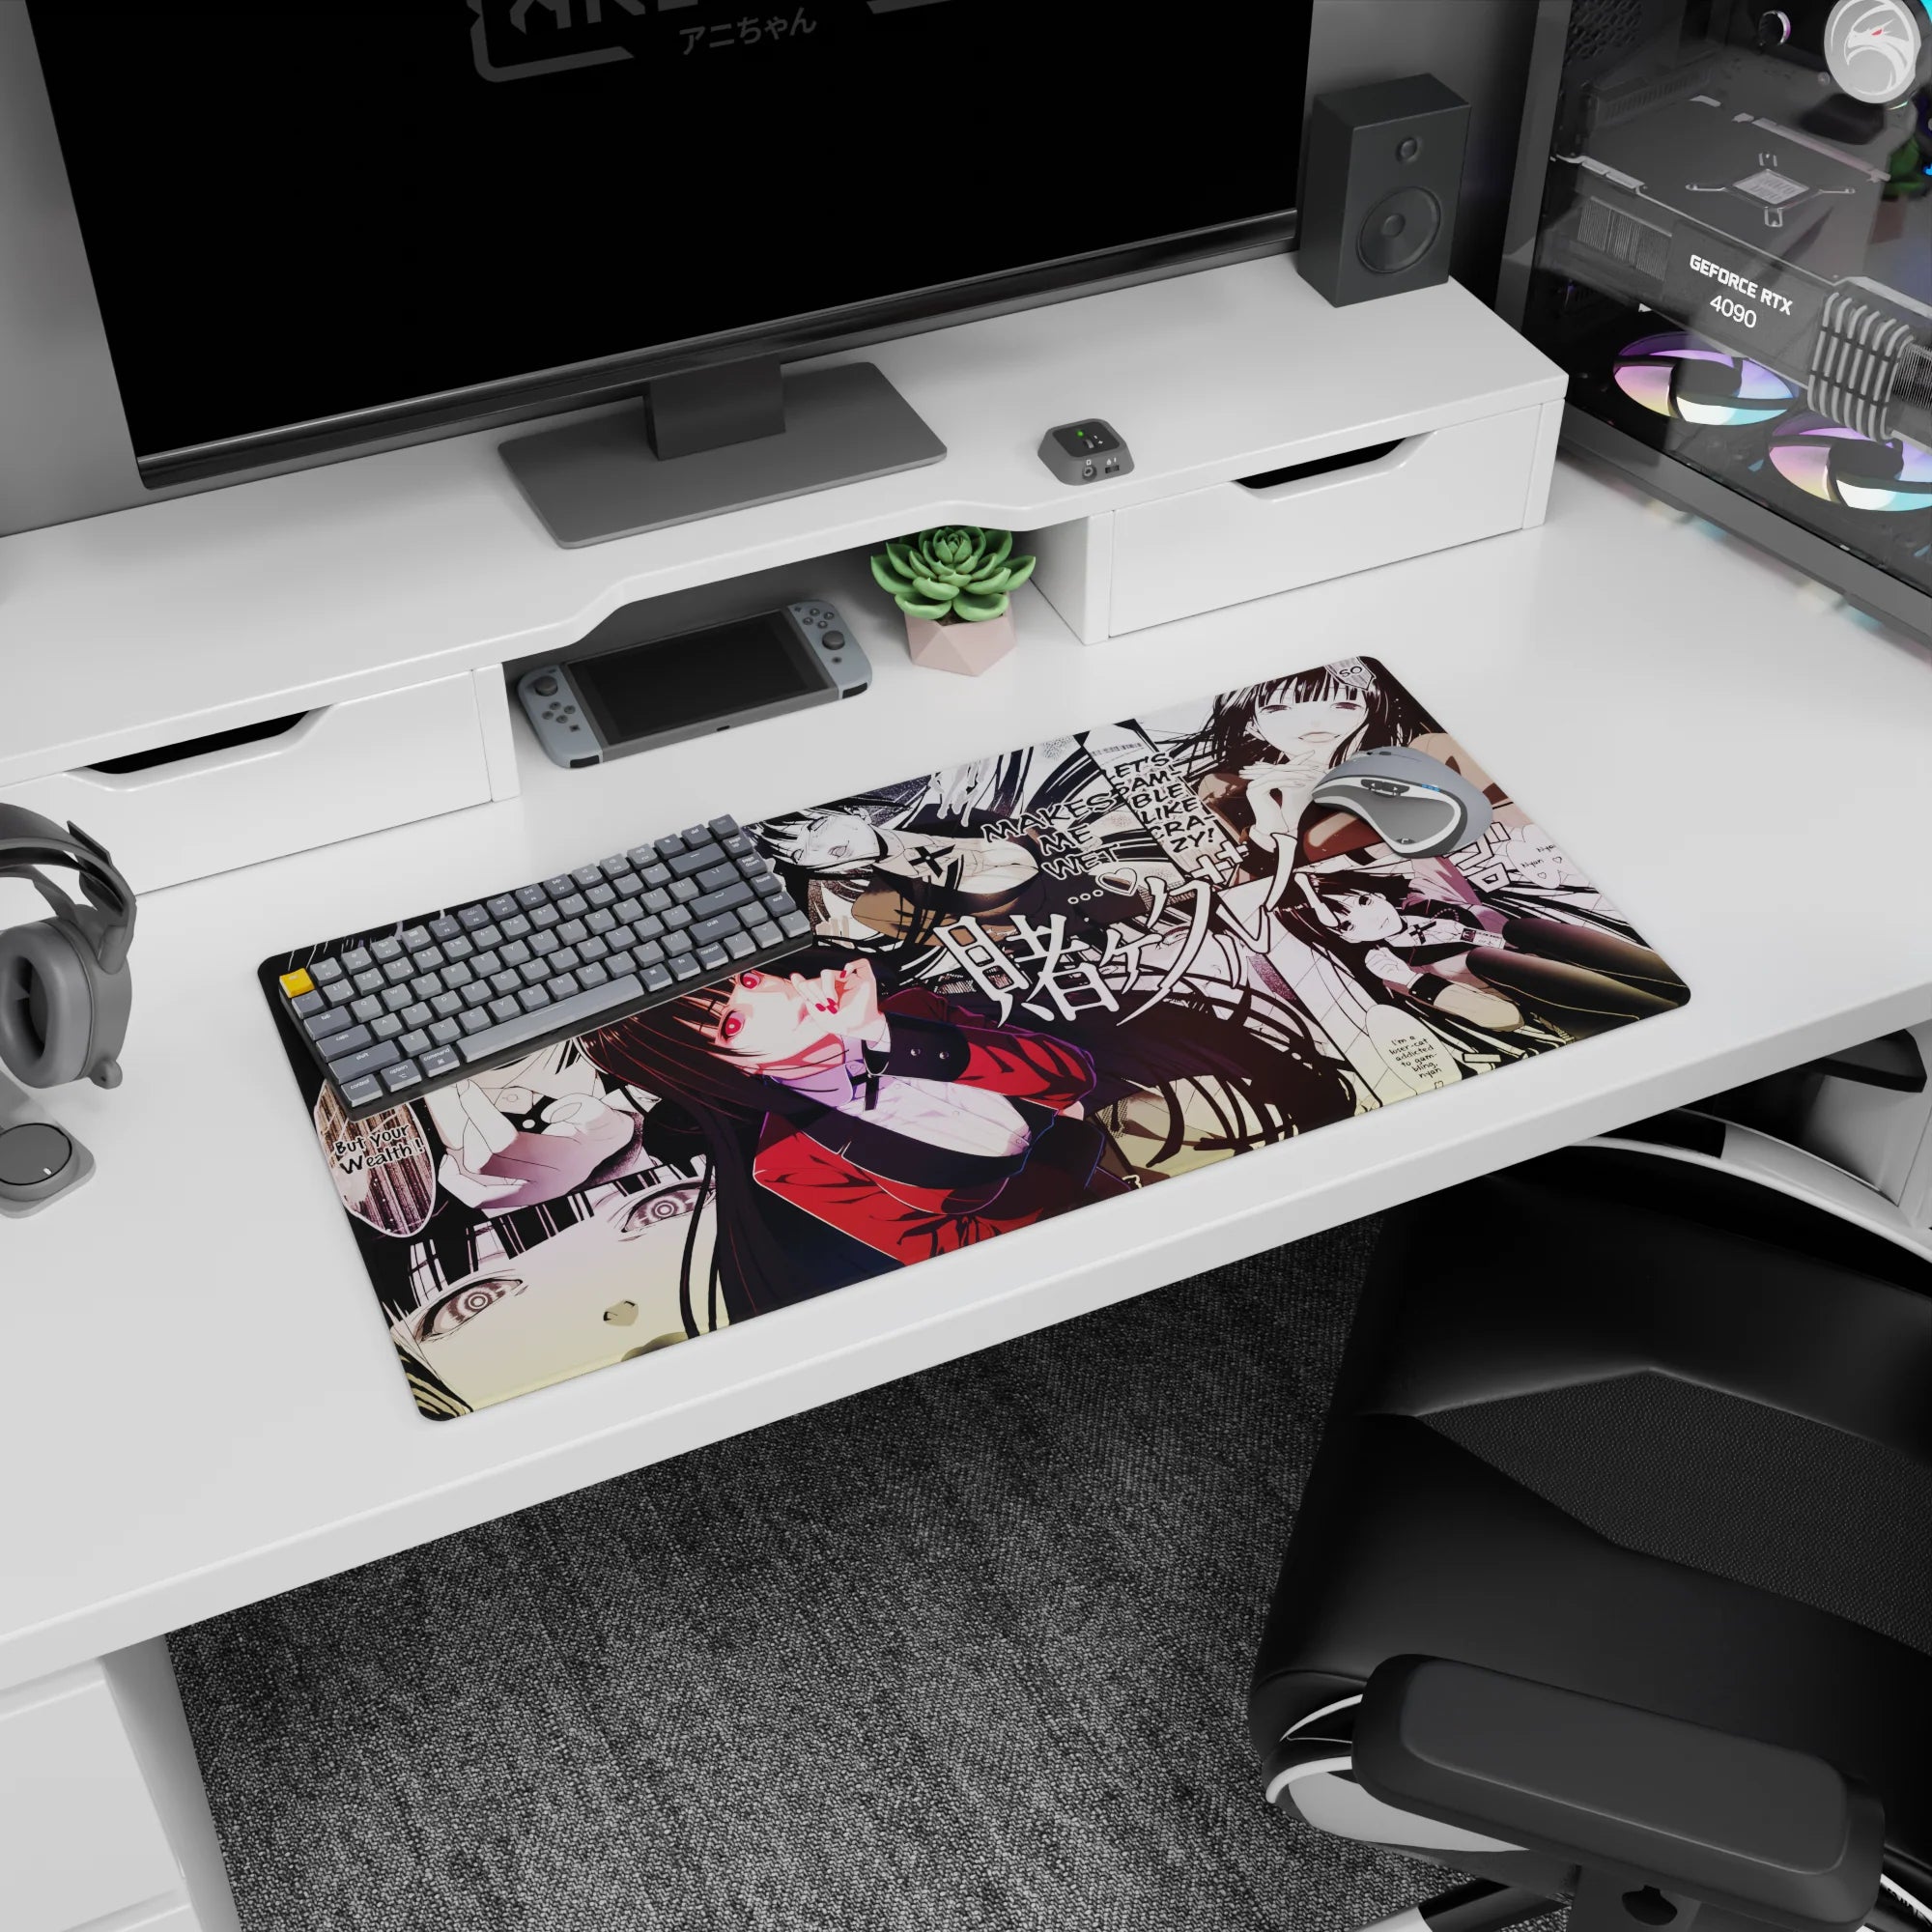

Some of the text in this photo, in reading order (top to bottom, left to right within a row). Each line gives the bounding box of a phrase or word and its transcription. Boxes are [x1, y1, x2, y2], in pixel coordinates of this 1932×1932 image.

[679, 6, 818, 56] アニちゃん
[1690, 254, 1793, 315] GEFORCE RTX
[1710, 295, 1757, 328] 4090
[1131, 782, 1183, 810] BLE
[981, 792, 1116, 843] MAKES
[1140, 796, 1198, 825] LIKE
[1038, 823, 1094, 857] ME
[1169, 828, 1214, 853] ZY!
[1041, 842, 1121, 880] WET
[700, 945, 719, 954] control
[423, 1047, 450, 1062] command
[1395, 1044, 1435, 1062] addicted
[389, 1065, 409, 1074] option
[350, 1078, 370, 1090] control
[335, 1138, 365, 1154] But
